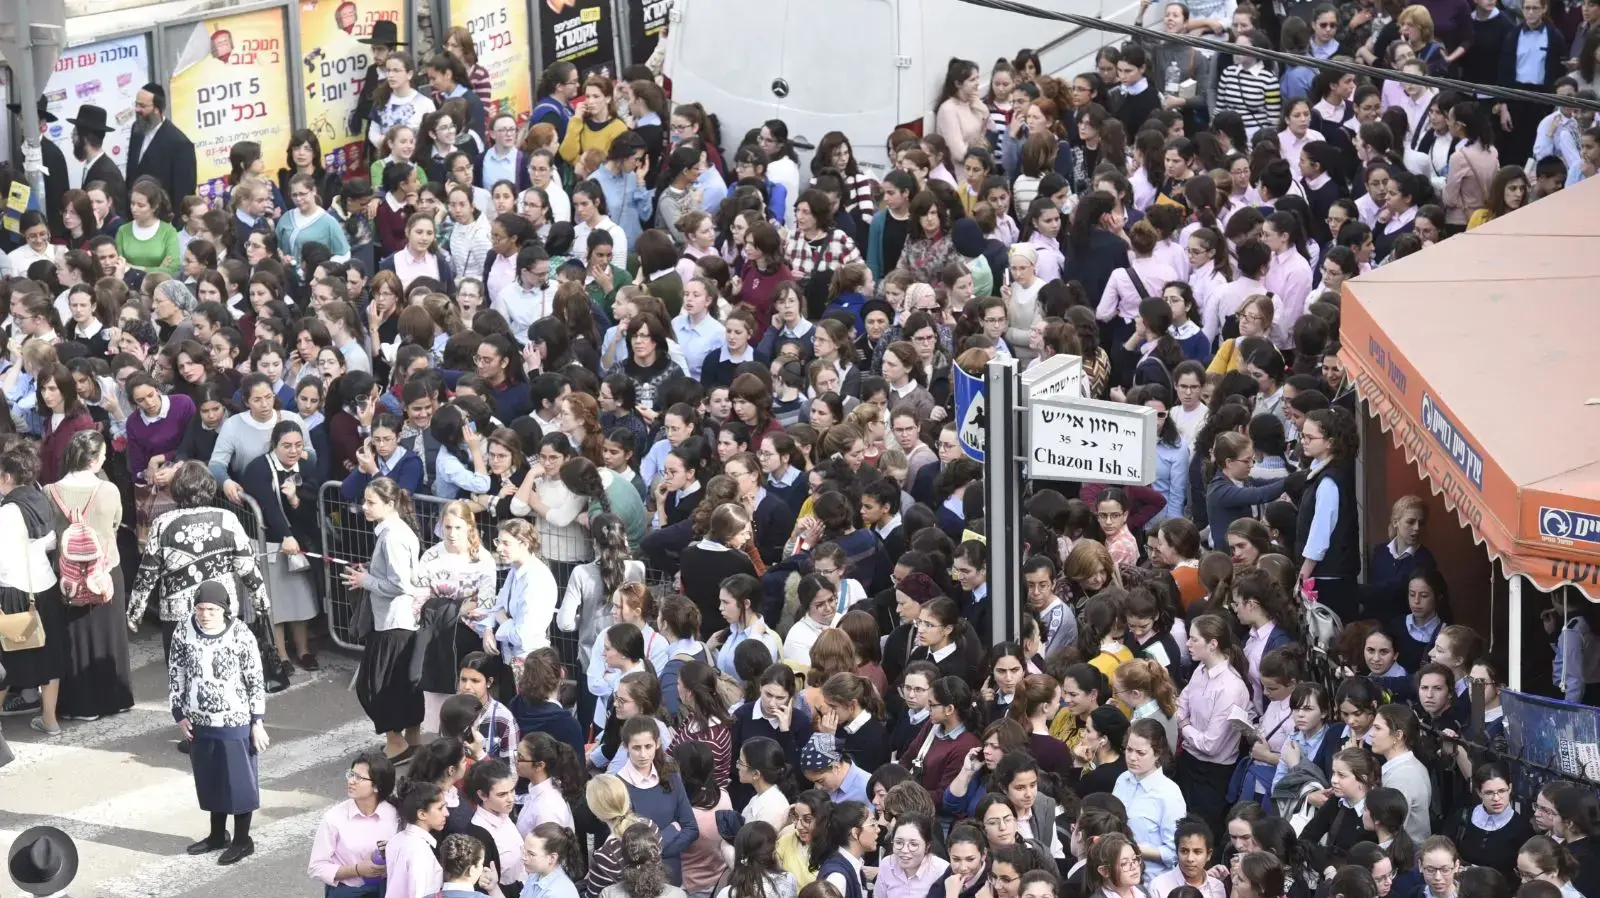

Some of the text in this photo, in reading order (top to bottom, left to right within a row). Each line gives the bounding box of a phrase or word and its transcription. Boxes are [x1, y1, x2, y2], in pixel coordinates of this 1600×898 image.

[499, 7, 507, 24] 5
[242, 38, 279, 51] חנוכה
[489, 30, 512, 51] בכל
[54, 45, 138, 72] חנוכה עם תנו
[320, 54, 368, 77] פרסים
[197, 77, 260, 104] 5 זוכים
[321, 82, 347, 103] יום!
[197, 101, 268, 129] בכל יום!
[1089, 417, 1119, 434] חזון
[1058, 434, 1072, 444] 35
[1110, 443, 1124, 452] 37
[1452, 430, 1465, 466] פיס
[1034, 446, 1141, 479] Chazon Ish St.
[1466, 445, 1482, 485] צריך
[1575, 516, 1600, 537] יים
